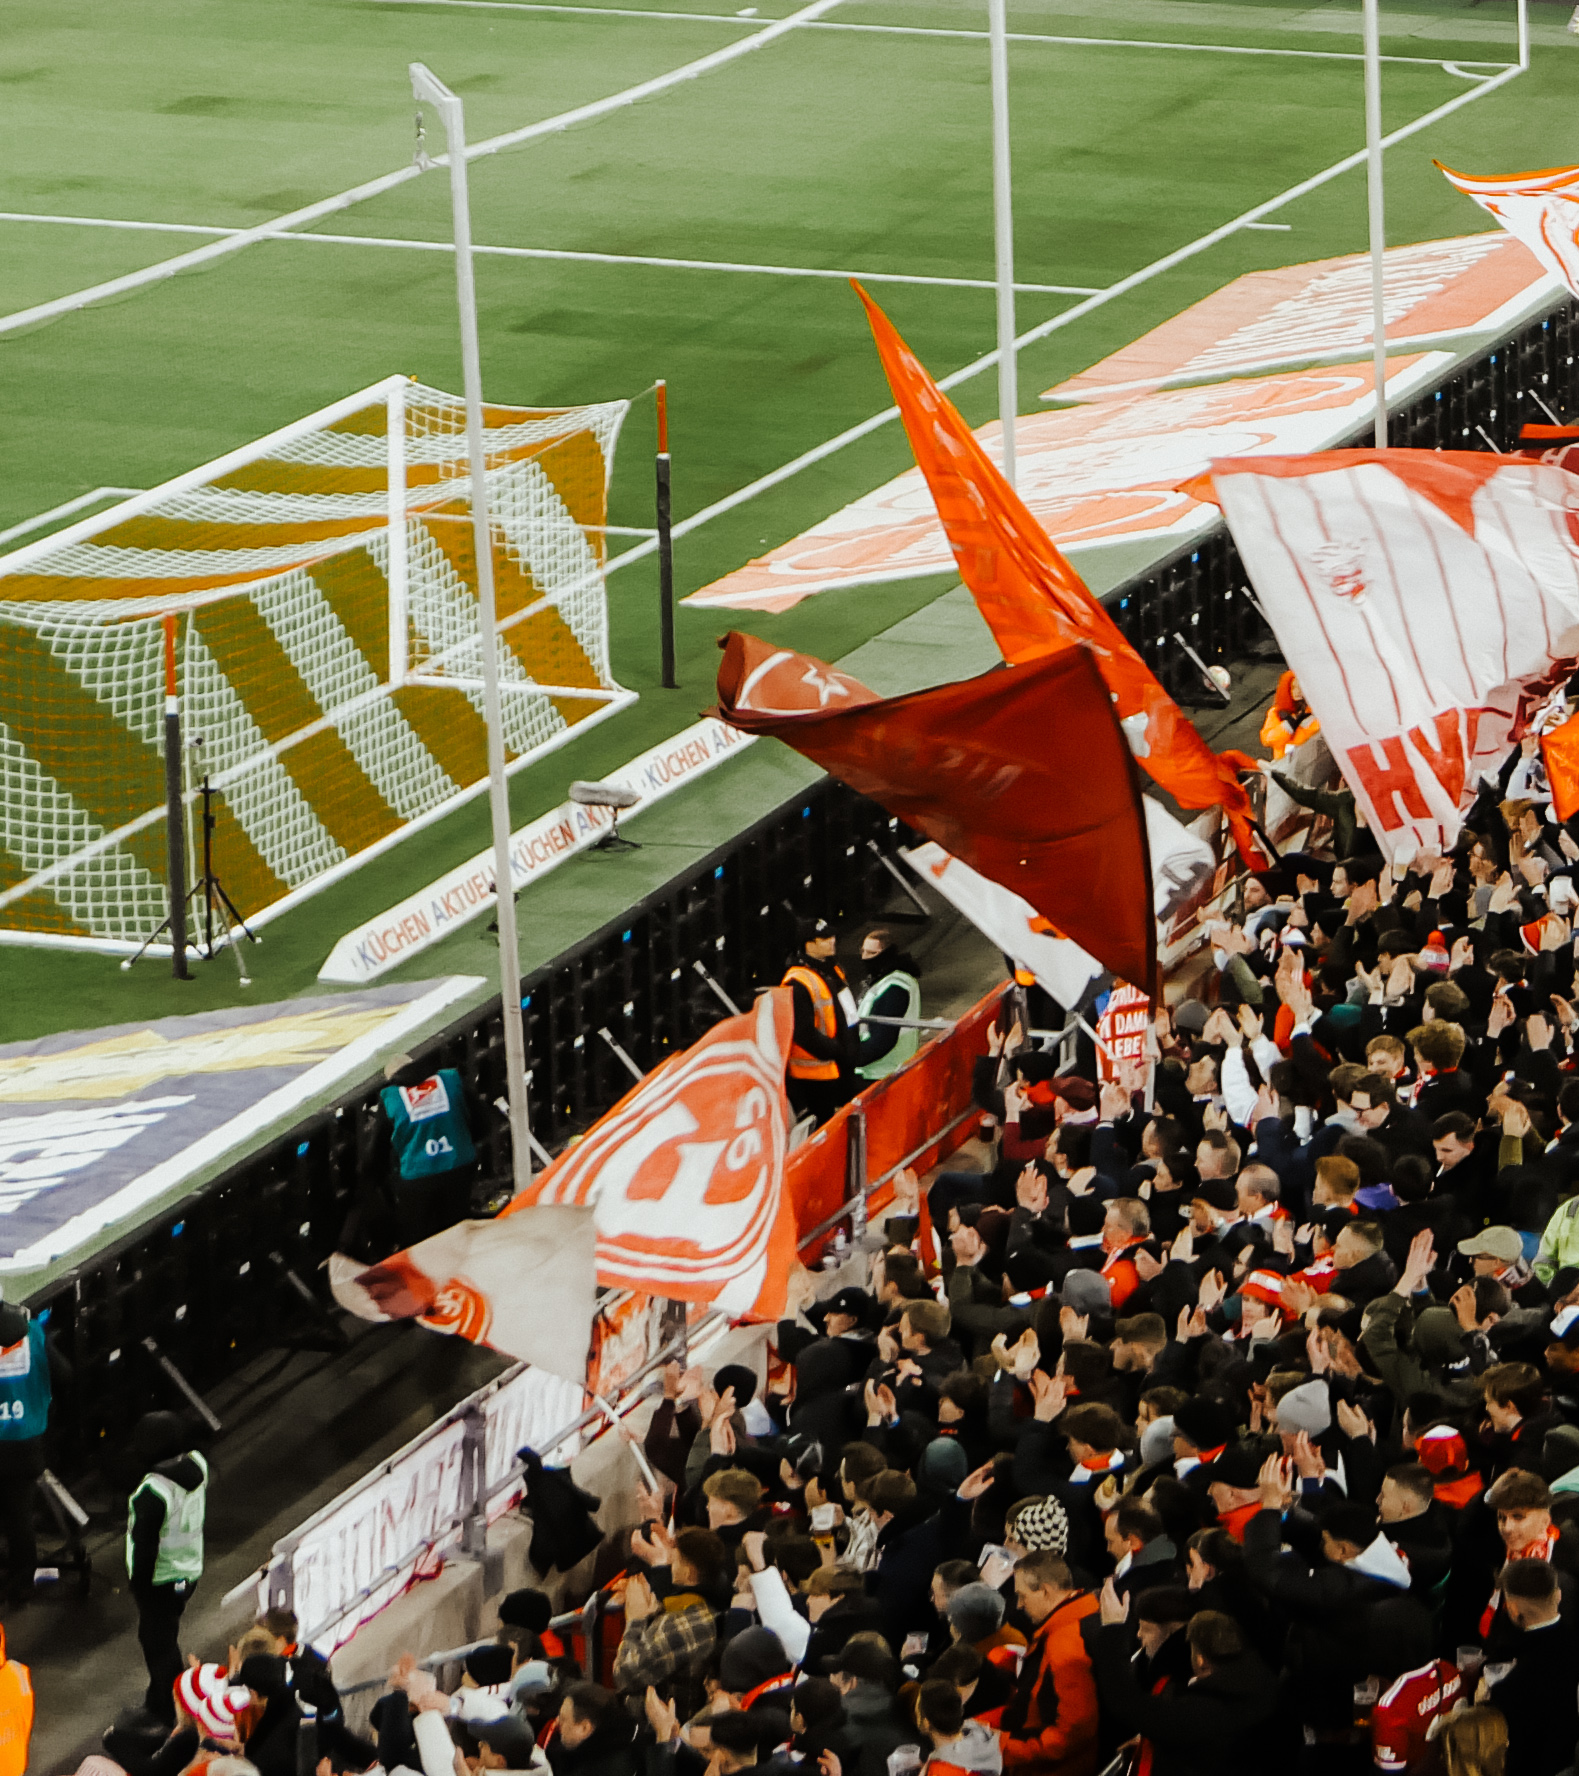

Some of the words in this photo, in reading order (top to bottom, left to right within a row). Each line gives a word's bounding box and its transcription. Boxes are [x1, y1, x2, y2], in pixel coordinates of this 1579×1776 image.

[642, 738, 710, 792] KÜCHEN
[510, 819, 576, 876] KÜCHEN
[357, 908, 432, 971] KÜCHEN
[425, 1135, 454, 1156] 01
